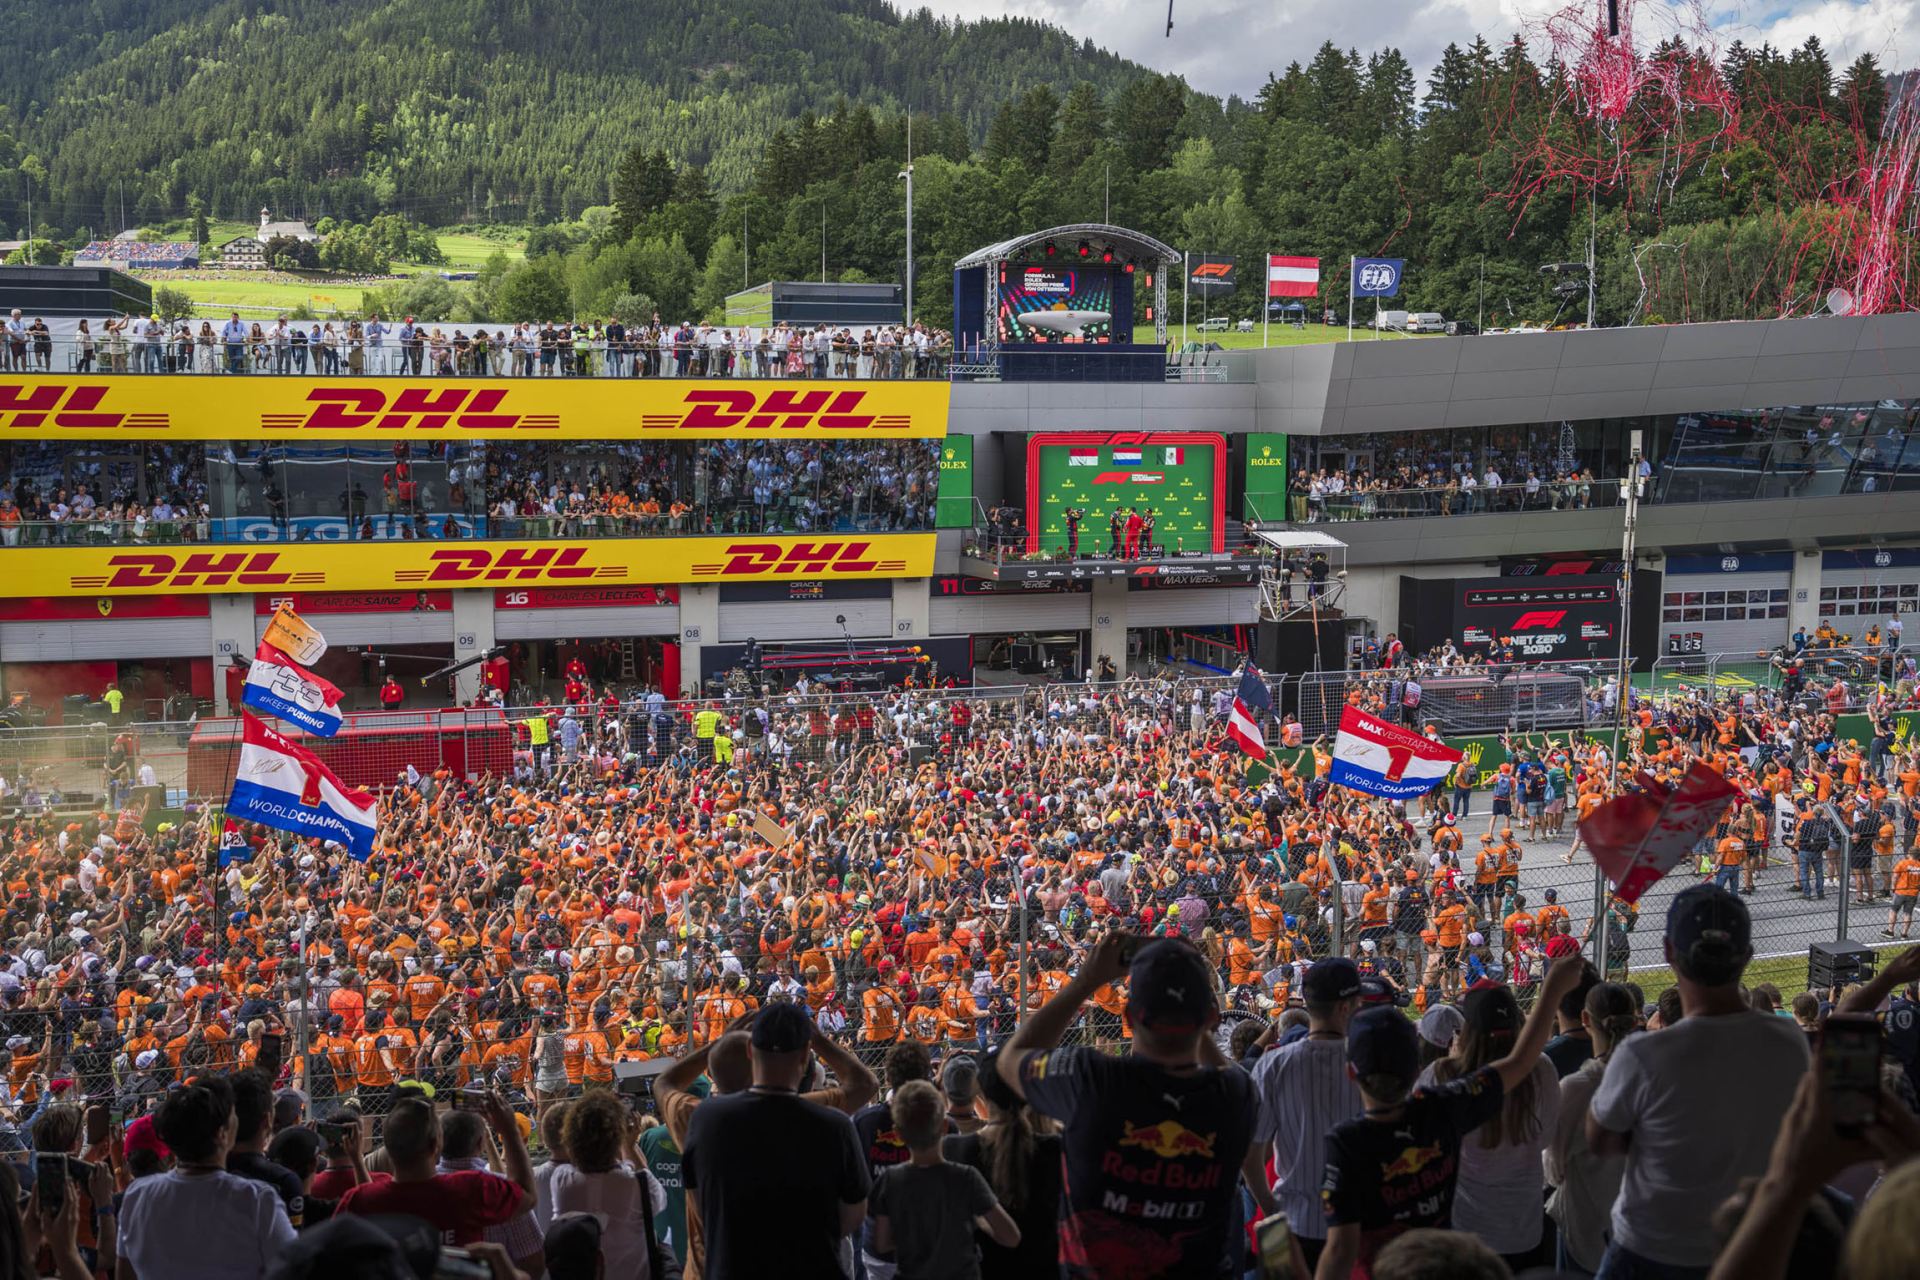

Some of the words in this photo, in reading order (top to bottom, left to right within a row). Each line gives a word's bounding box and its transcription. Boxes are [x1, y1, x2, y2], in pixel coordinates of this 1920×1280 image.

[1361, 269, 1392, 286] FIA
[0, 385, 127, 428] HL
[304, 388, 522, 429] DHL
[680, 390, 876, 429] DHL
[940, 460, 967, 470] OLEX
[1250, 458, 1282, 467] ROLEX
[721, 542, 879, 575] DHL
[107, 552, 292, 588] DHL
[428, 548, 597, 581] DHL
[1163, 575, 1188, 584] MAX
[940, 579, 958, 594] 11
[363, 596, 402, 606] SAINZ
[505, 591, 529, 605] 16
[598, 590, 647, 601] LECLERC
[1097, 616, 1110, 625] 06
[1510, 610, 1568, 630] F1
[898, 622, 911, 632] 07
[686, 629, 699, 638] 08
[459, 636, 474, 645] 09
[1510, 635, 1533, 646] NET
[1671, 641, 1679, 651] 1
[1692, 639, 1701, 650] 3
[218, 643, 231, 652] 10
[1523, 644, 1553, 655] 2030
[1103, 1150, 1163, 1186] Red
[1165, 1162, 1222, 1189] Bull
[659, 1178, 682, 1188] ara
[1103, 1190, 1175, 1219] Mobil
